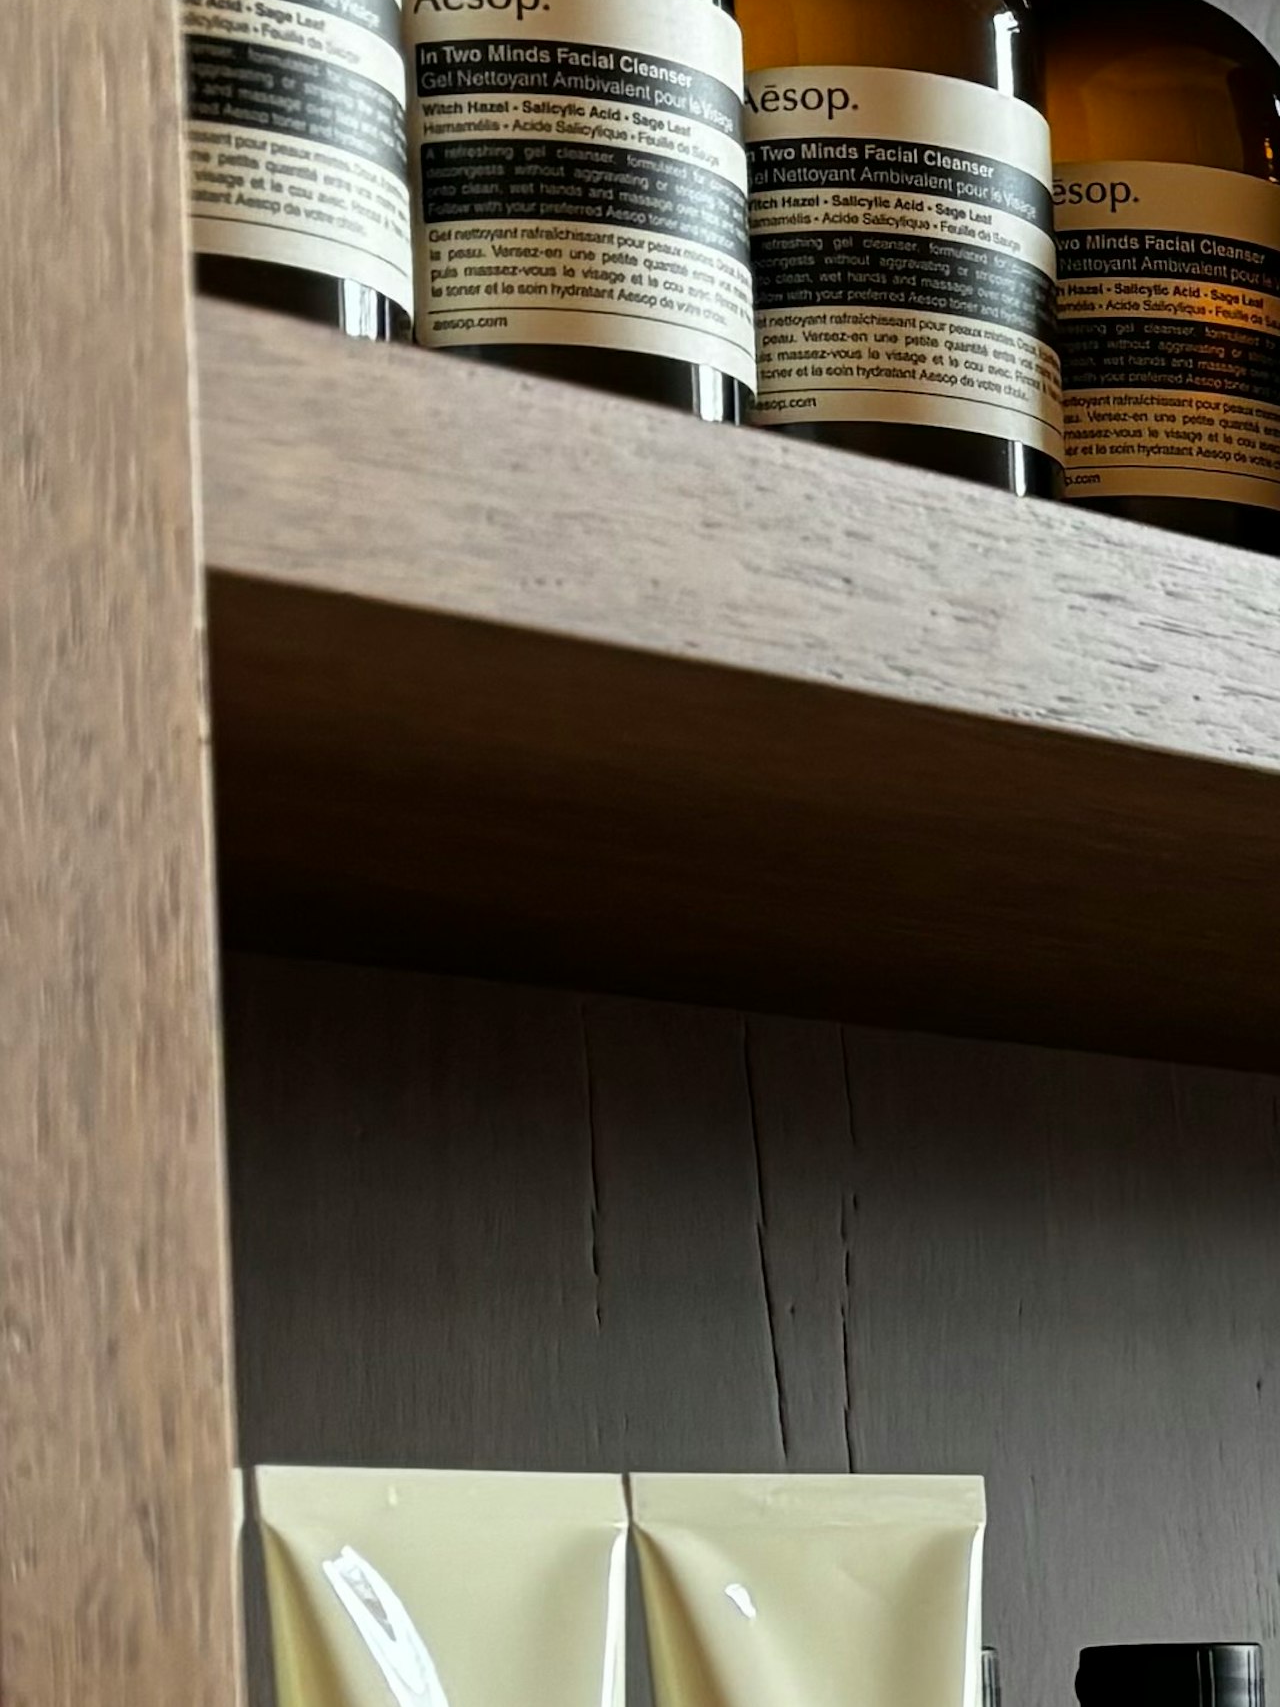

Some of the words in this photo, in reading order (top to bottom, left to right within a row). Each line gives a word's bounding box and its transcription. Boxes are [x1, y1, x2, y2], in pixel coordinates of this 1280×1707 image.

[421, 48, 438, 64] In
[444, 46, 482, 64] Two
[487, 44, 551, 64] Minds
[556, 48, 615, 70] Facial
[619, 57, 693, 88] Cleanser
[421, 71, 453, 90] Gel
[456, 71, 548, 93] Nettoyant
[553, 75, 651, 101] Ambivalent
[654, 89, 687, 109] pour
[589, 104, 621, 121] Acid
[761, 145, 795, 162] Two
[800, 142, 859, 160] Minds
[864, 144, 918, 165] Facial
[923, 150, 996, 179] Cleanser
[1085, 233, 1140, 251] Minds
[1145, 234, 1196, 254] Facial
[1200, 239, 1267, 265] Cleanser
